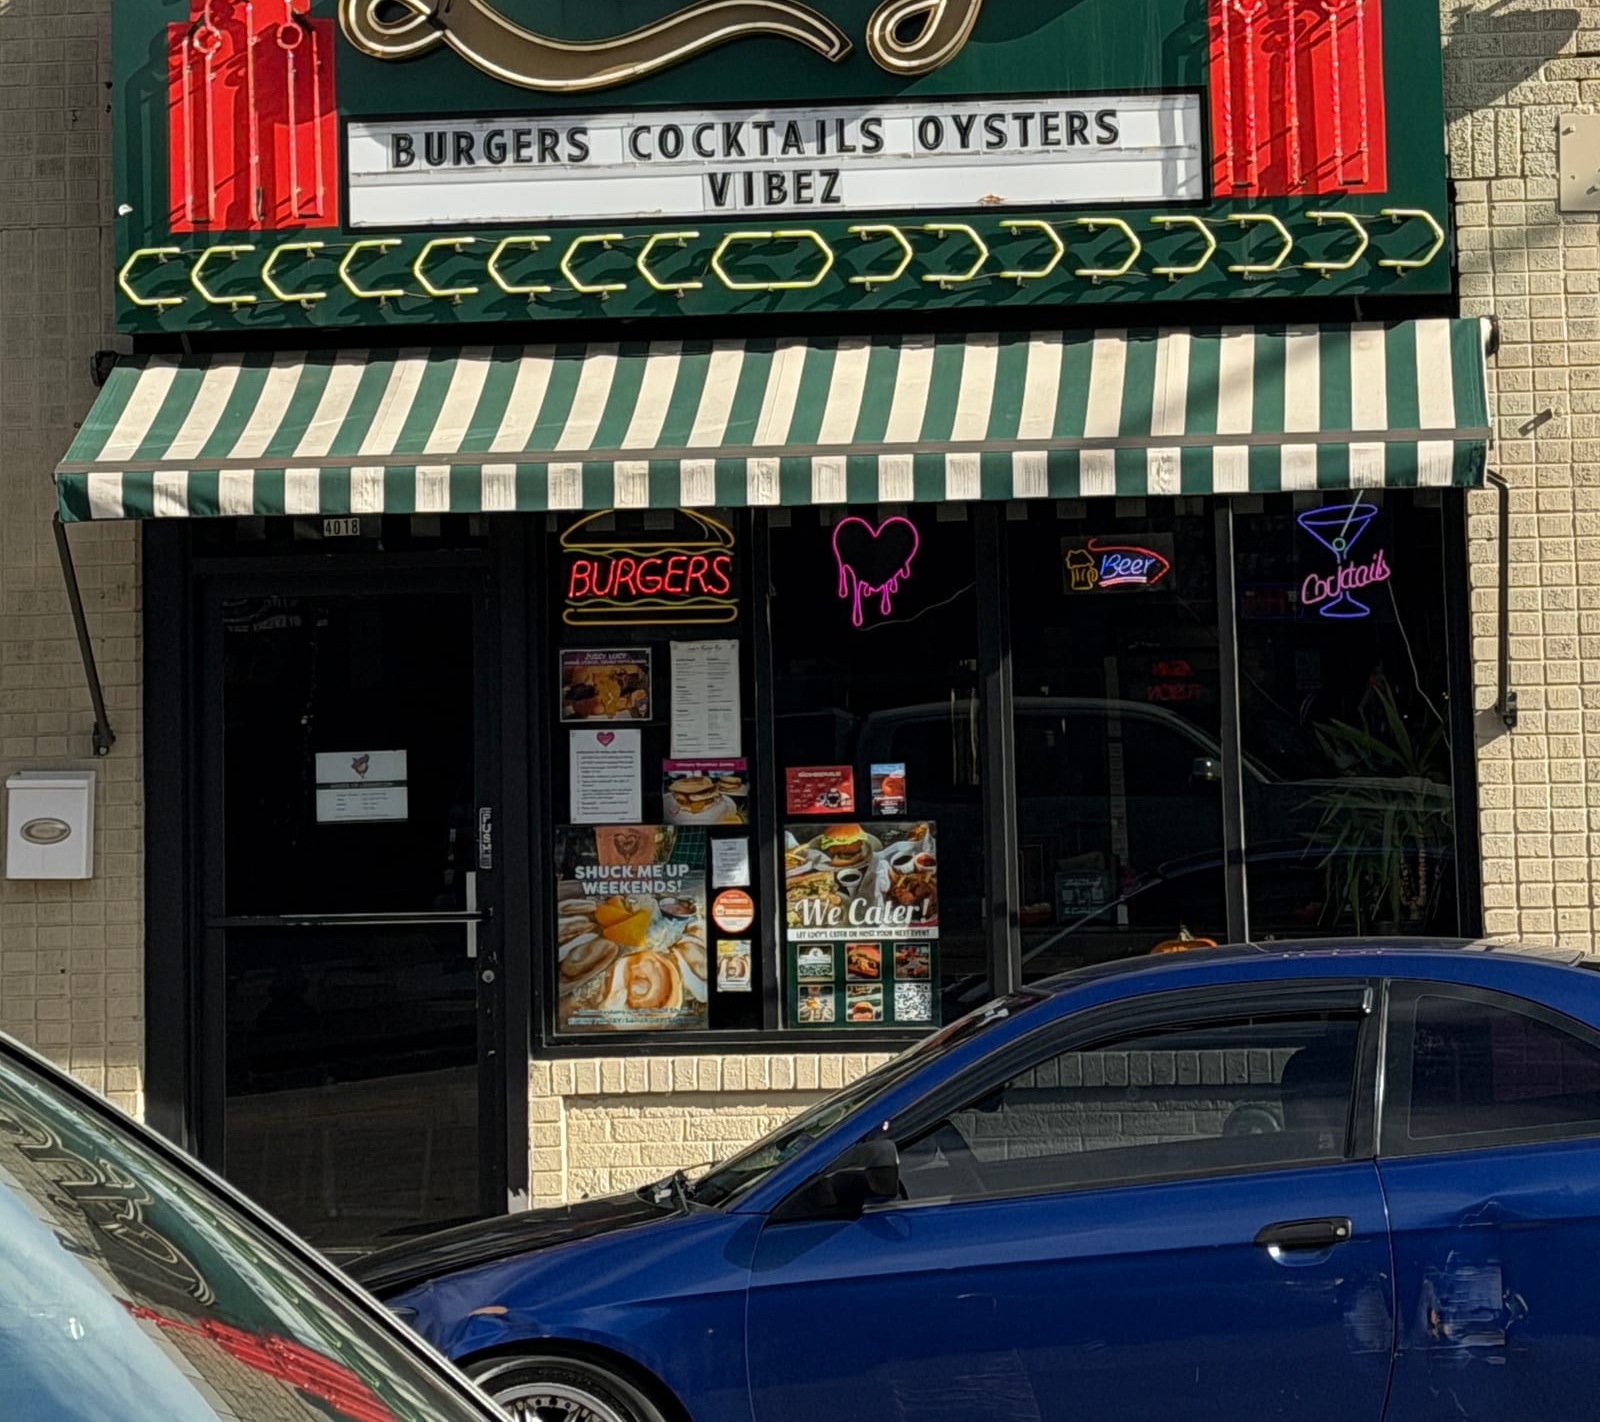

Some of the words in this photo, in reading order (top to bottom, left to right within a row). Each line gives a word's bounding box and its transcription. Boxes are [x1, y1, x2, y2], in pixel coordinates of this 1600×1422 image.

[391, 124, 590, 167] BURGERS
[629, 116, 884, 160] COCKTAILS
[918, 108, 1121, 151] OYSTERS
[707, 169, 843, 208] VIBEZ
[325, 520, 358, 535] 4018
[568, 556, 731, 598] BURGERS
[1100, 553, 1156, 576] Beer
[1302, 549, 1391, 604] Cocktails
[575, 865, 633, 880] SHUCK
[637, 865, 662, 878] ME
[666, 864, 689, 878] UP
[583, 881, 682, 895] WEEKENDS!
[795, 899, 841, 926] We
[849, 898, 929, 925] Cater!
